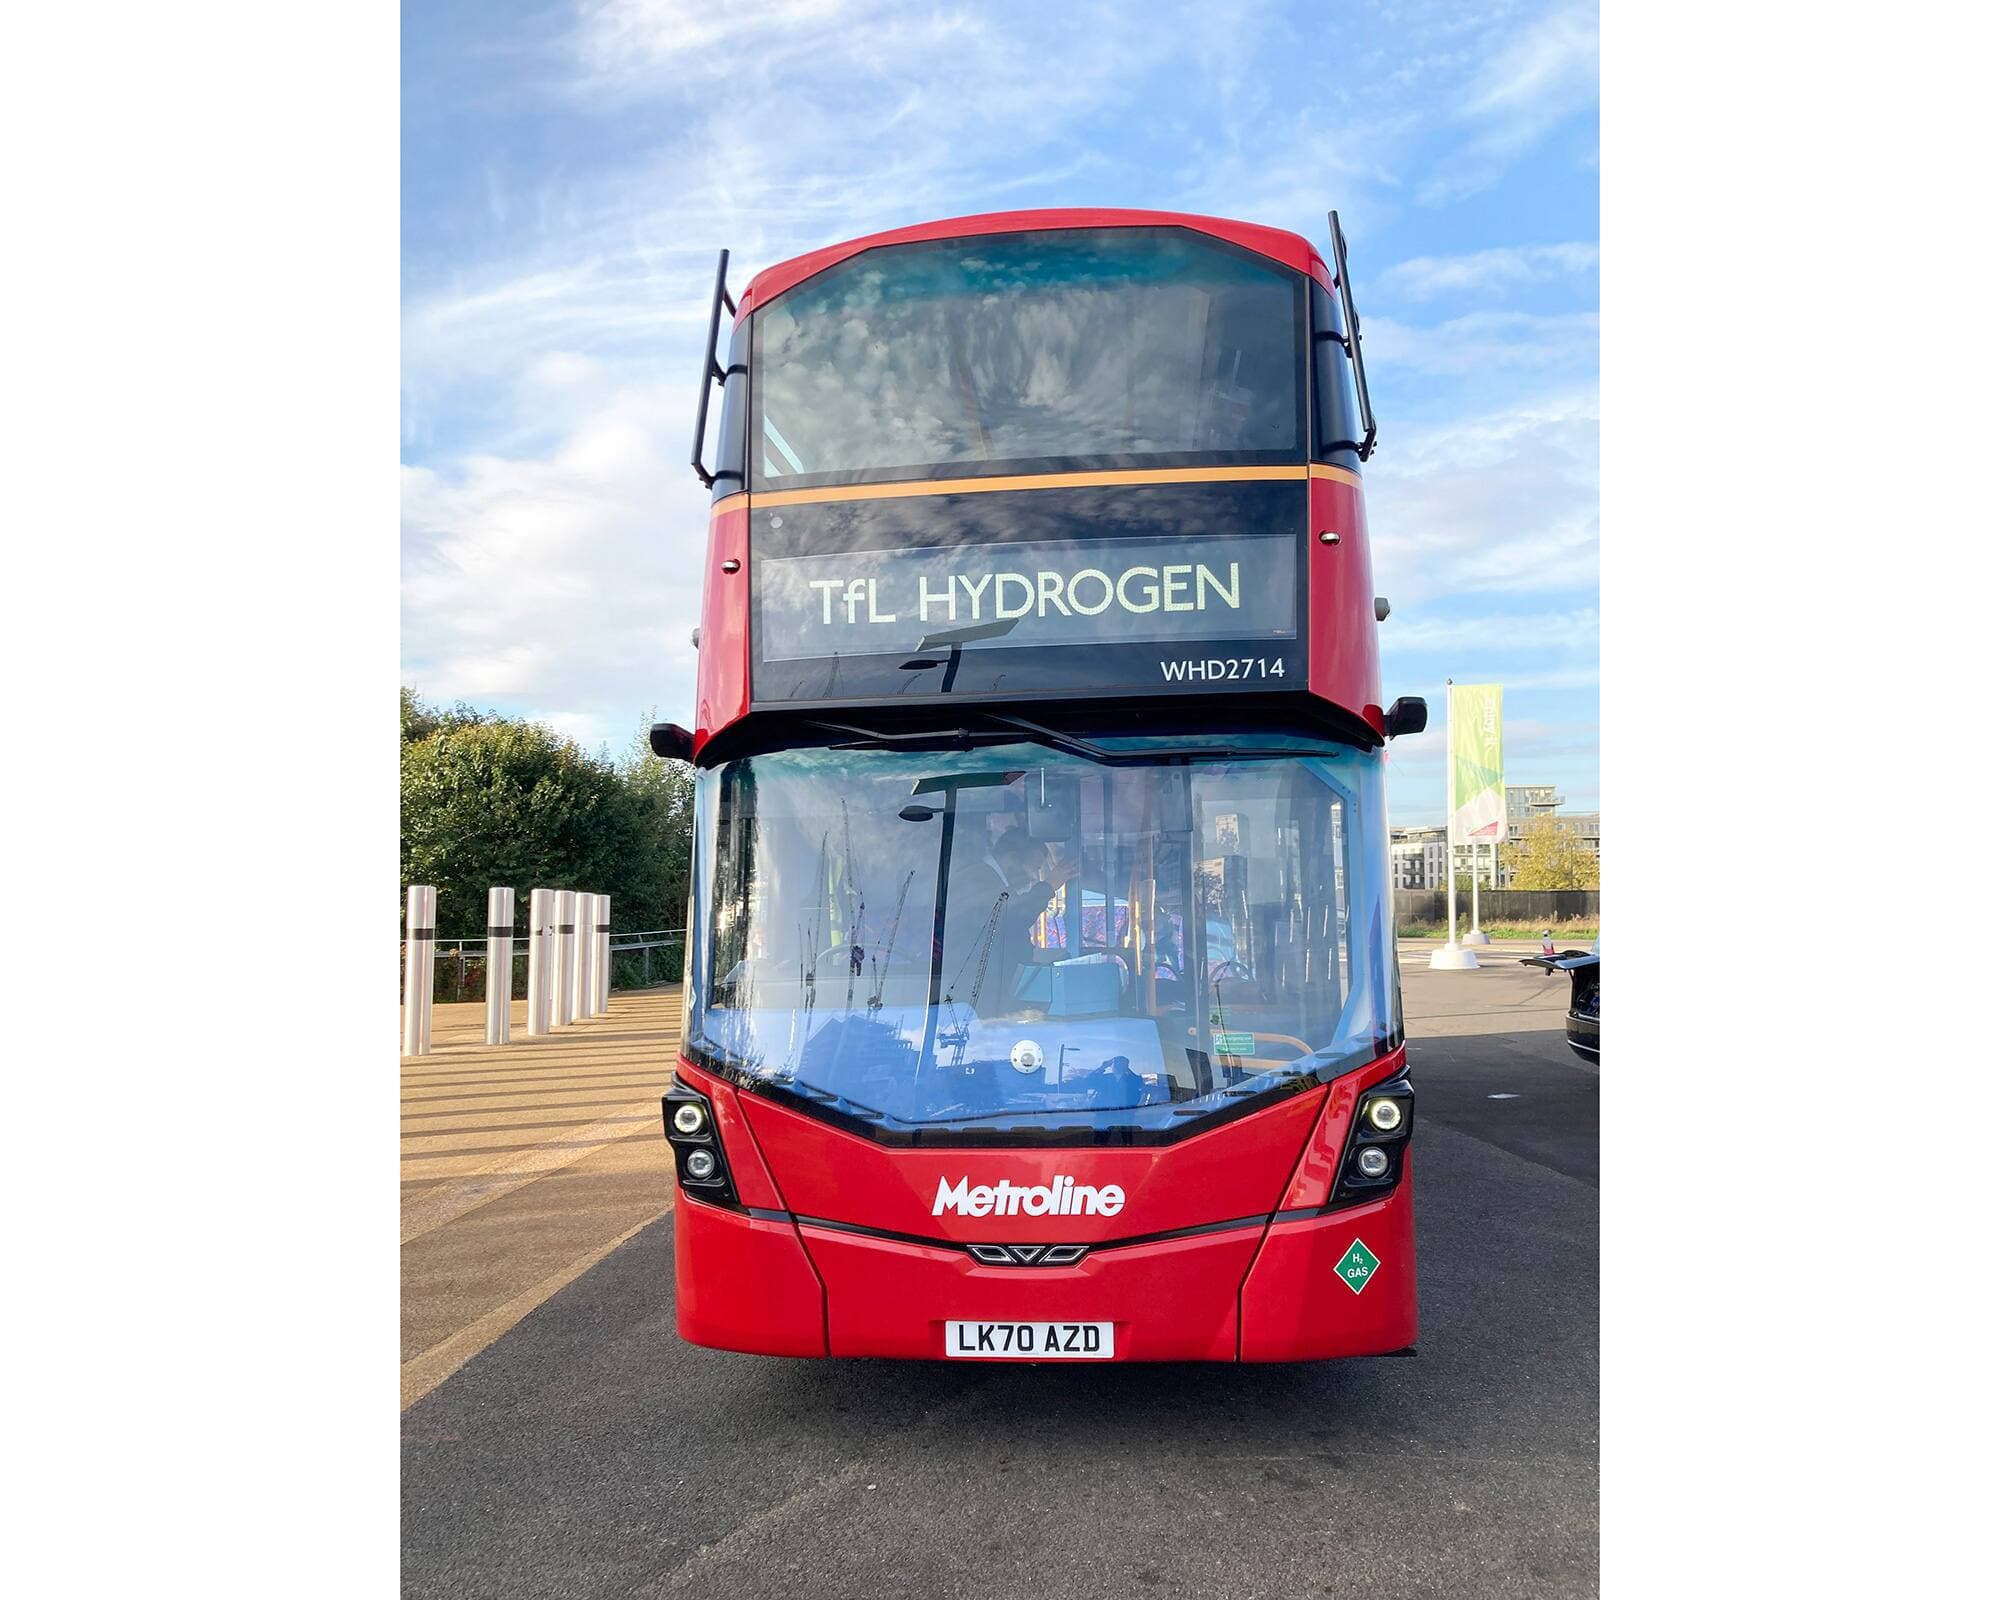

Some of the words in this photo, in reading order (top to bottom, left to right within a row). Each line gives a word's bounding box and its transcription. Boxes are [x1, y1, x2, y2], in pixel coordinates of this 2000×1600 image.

[809, 578, 897, 625] TfL
[919, 562, 1240, 622] HYDROGEN
[1160, 658, 1285, 681] WHD2714
[931, 1175, 1126, 1217] Metroline
[1347, 1266, 1369, 1279] GAS
[959, 1324, 1034, 1352] LK70
[1044, 1325, 1100, 1352] AZD
